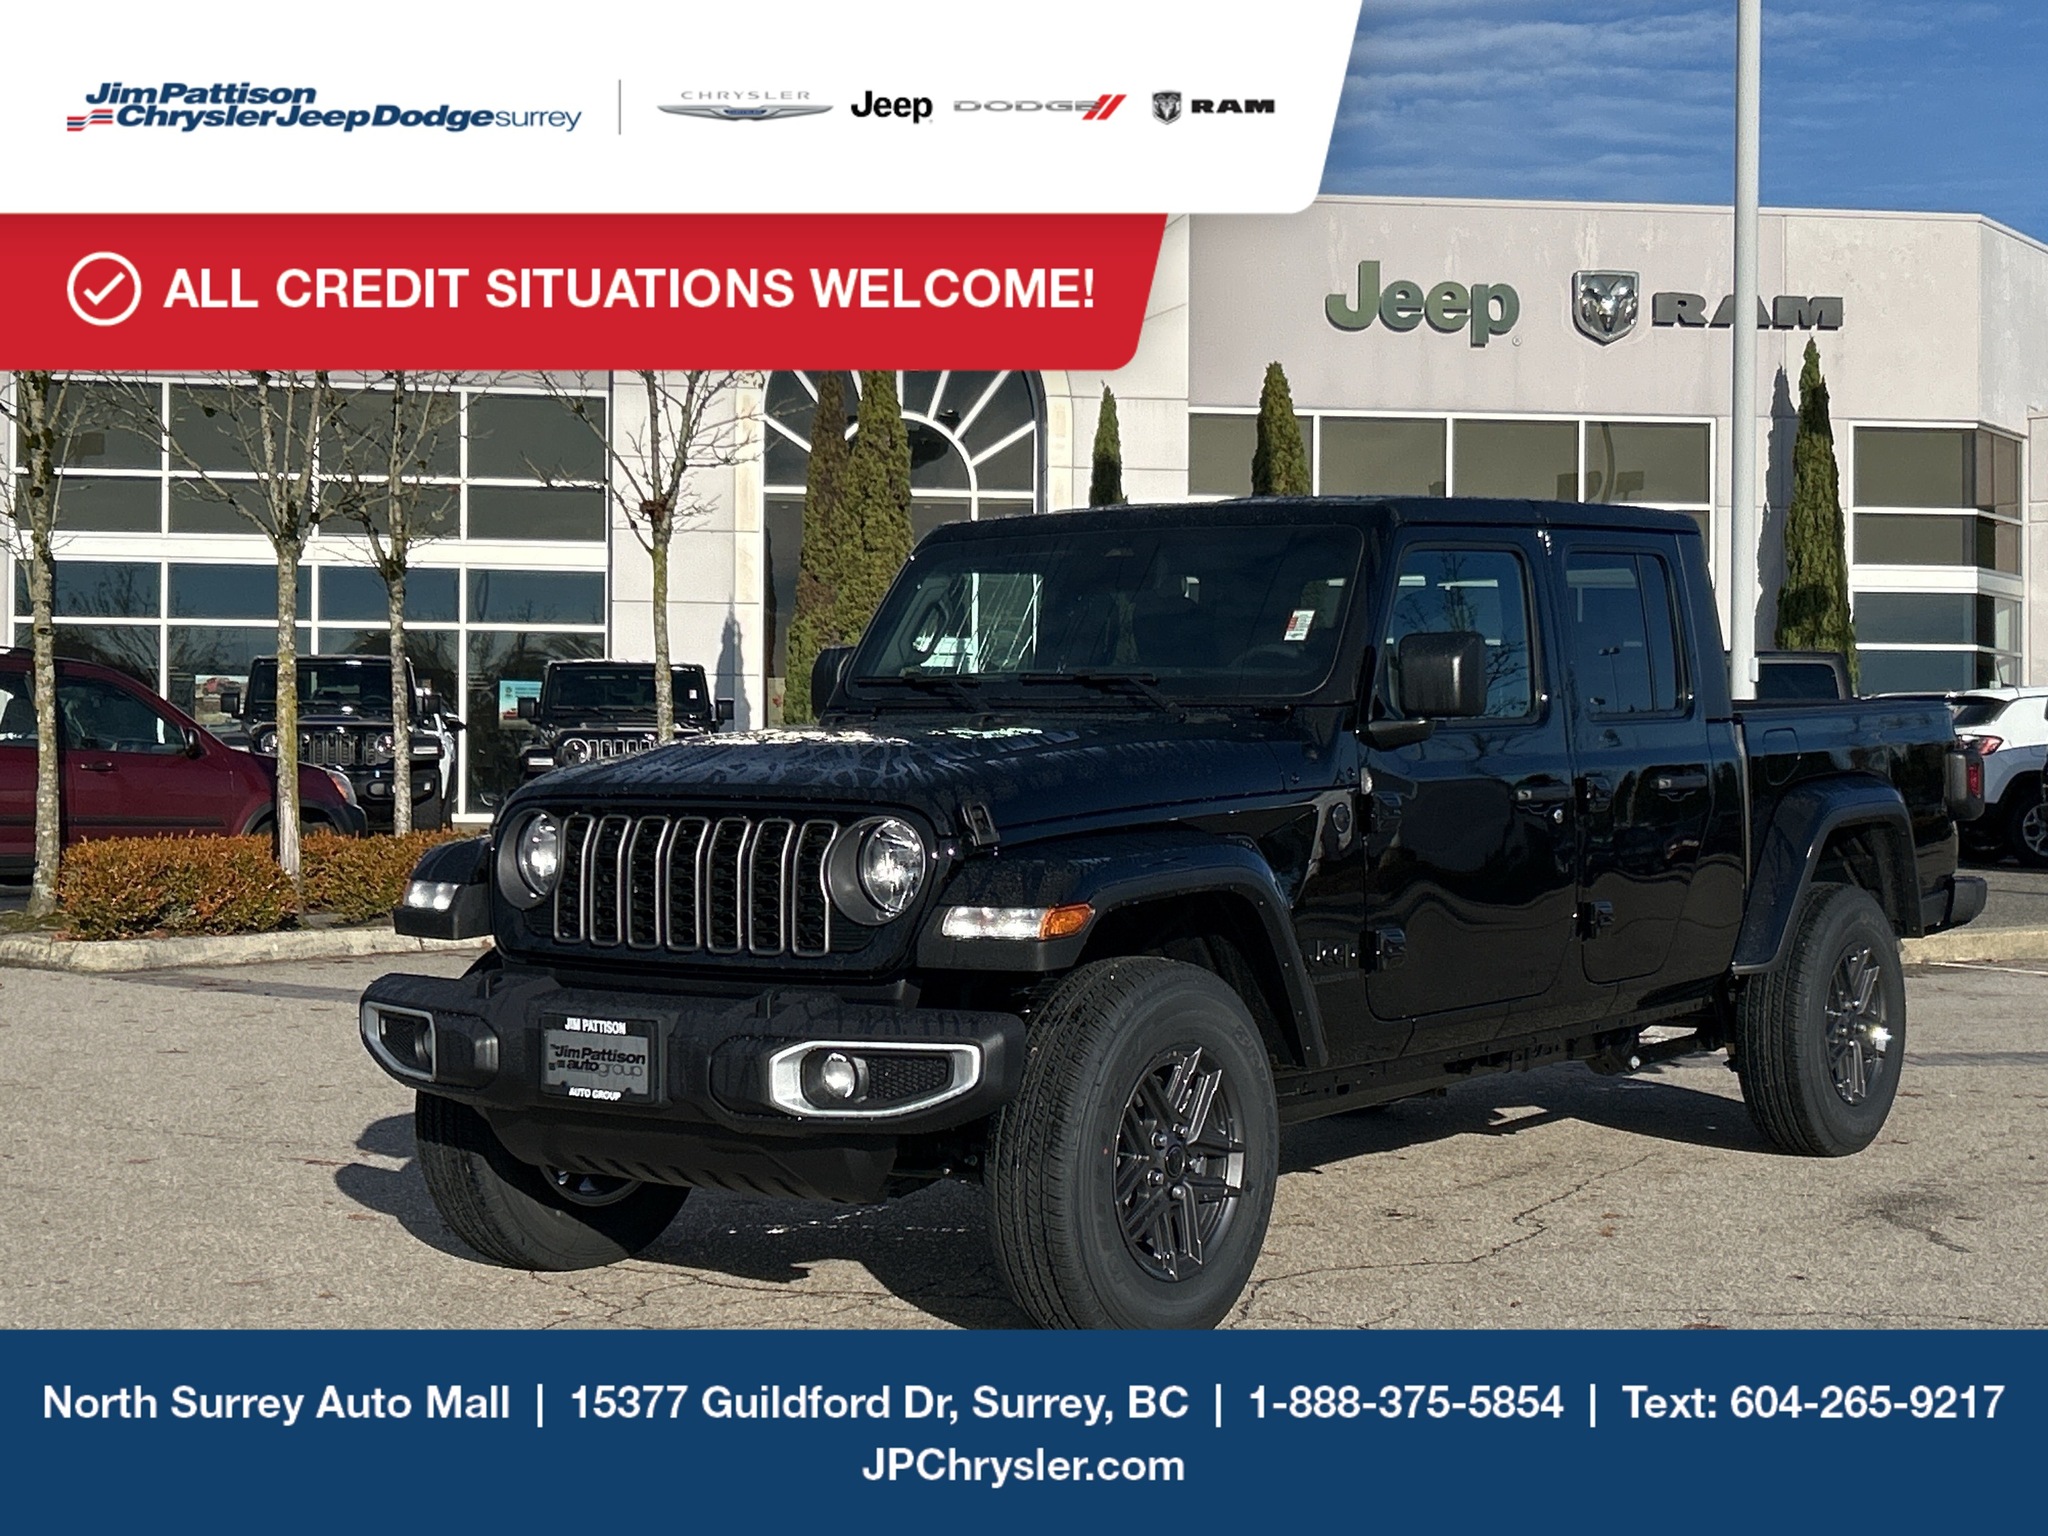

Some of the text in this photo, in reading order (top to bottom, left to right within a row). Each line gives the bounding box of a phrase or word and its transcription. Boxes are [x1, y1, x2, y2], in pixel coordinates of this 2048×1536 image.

[1325, 260, 1520, 348] Jeep
[564, 1017, 627, 1035] JIM PATTISON
[555, 1045, 645, 1065] Jim Pattison
[568, 1086, 622, 1101] AUTO GROUP
